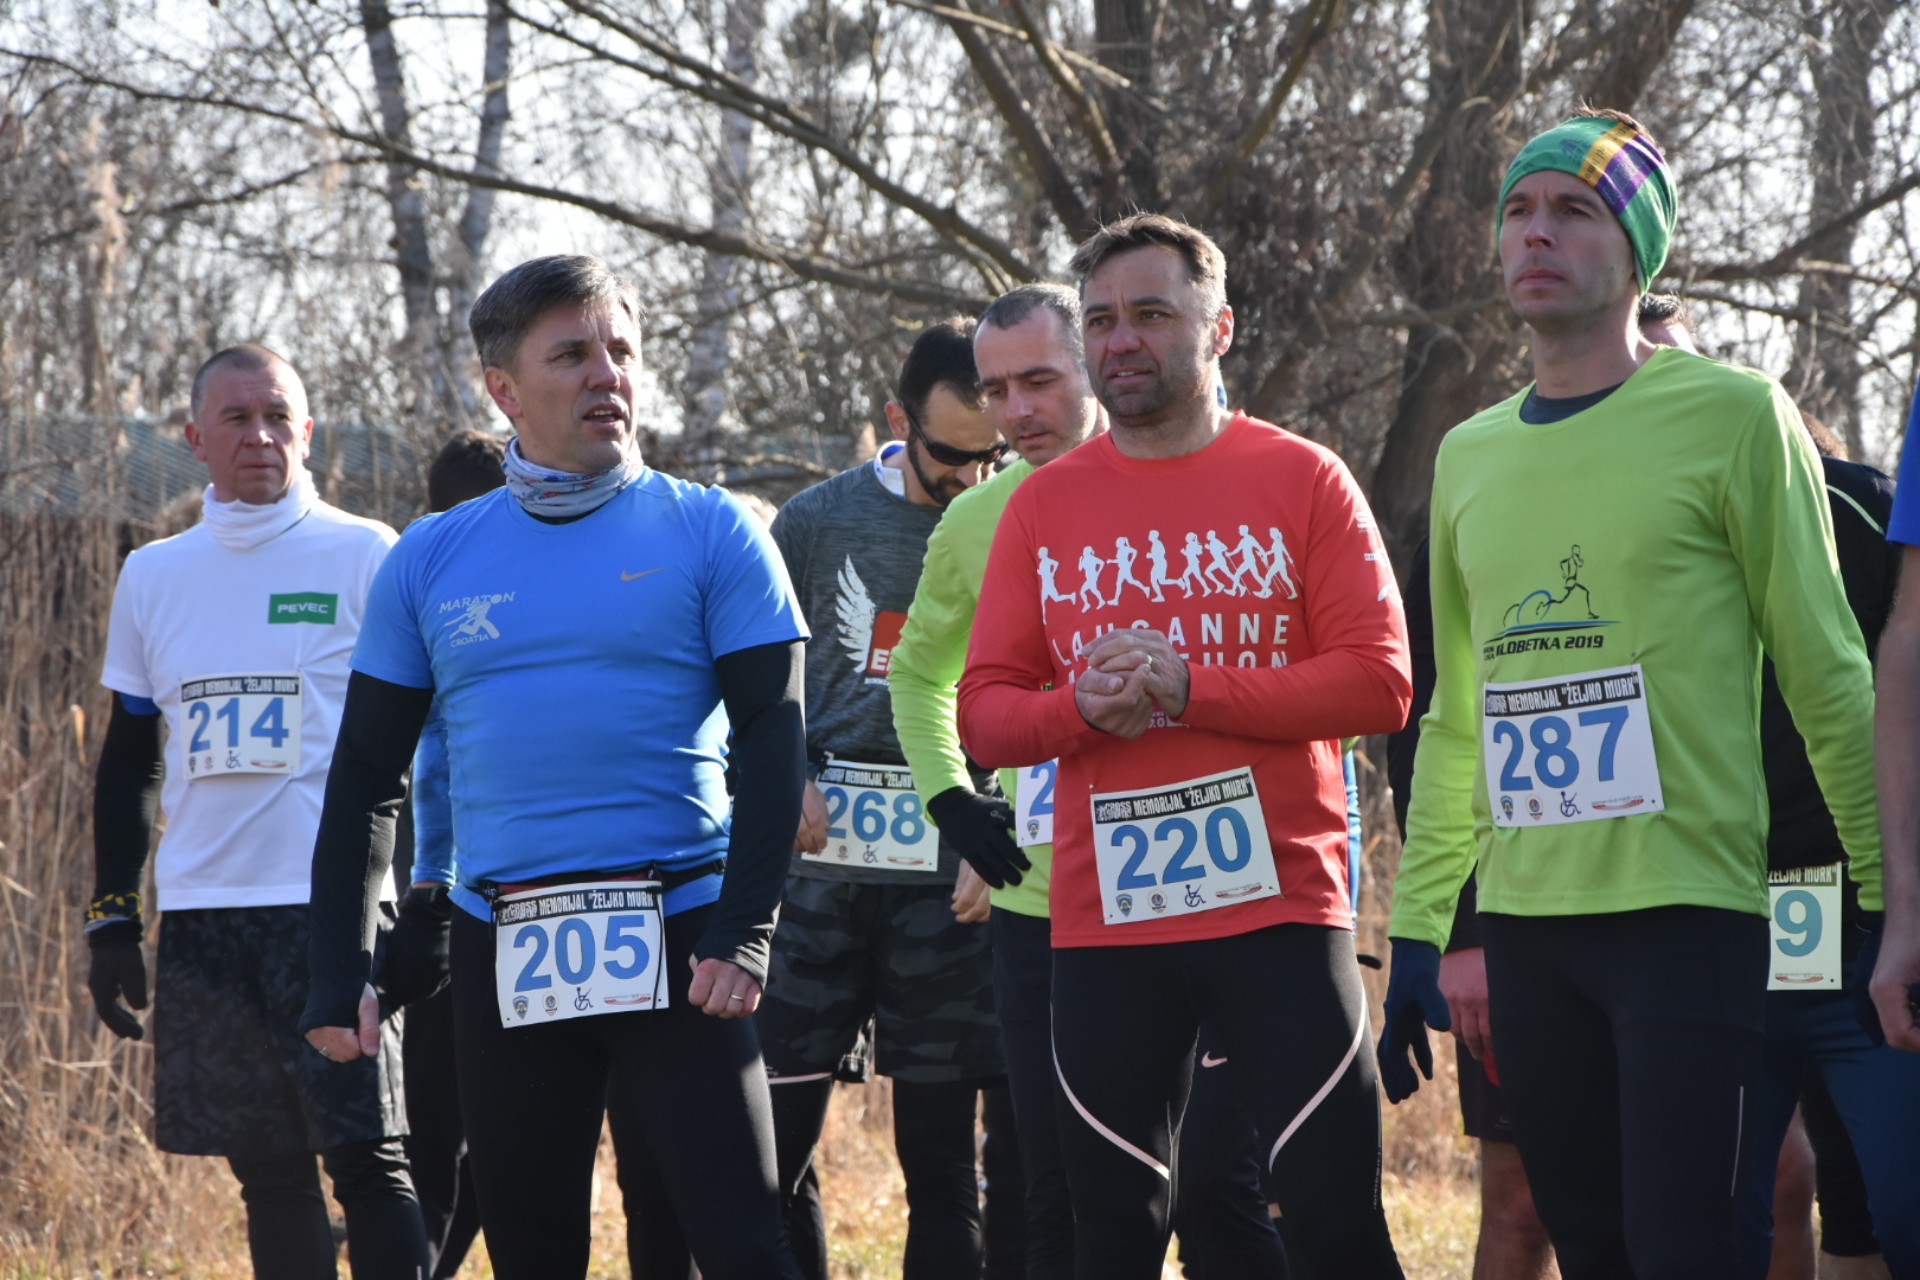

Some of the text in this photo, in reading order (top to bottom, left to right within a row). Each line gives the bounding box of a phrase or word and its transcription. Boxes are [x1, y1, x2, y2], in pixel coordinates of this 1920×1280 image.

[277, 602, 329, 614] PEVEC
[439, 592, 516, 614] MARATON
[450, 634, 490, 648] CROATIA
[1564, 635, 1604, 649] 2019
[1507, 688, 1562, 713] MEMORIJAL
[188, 697, 289, 754] 214
[1493, 705, 1629, 791] 287
[824, 787, 926, 846] 268
[1133, 793, 1185, 816] MEMORIJAL
[1111, 806, 1252, 891] 220
[539, 893, 587, 916] MEMORIJAL
[1774, 889, 1823, 957] 9
[513, 914, 650, 993] 205
